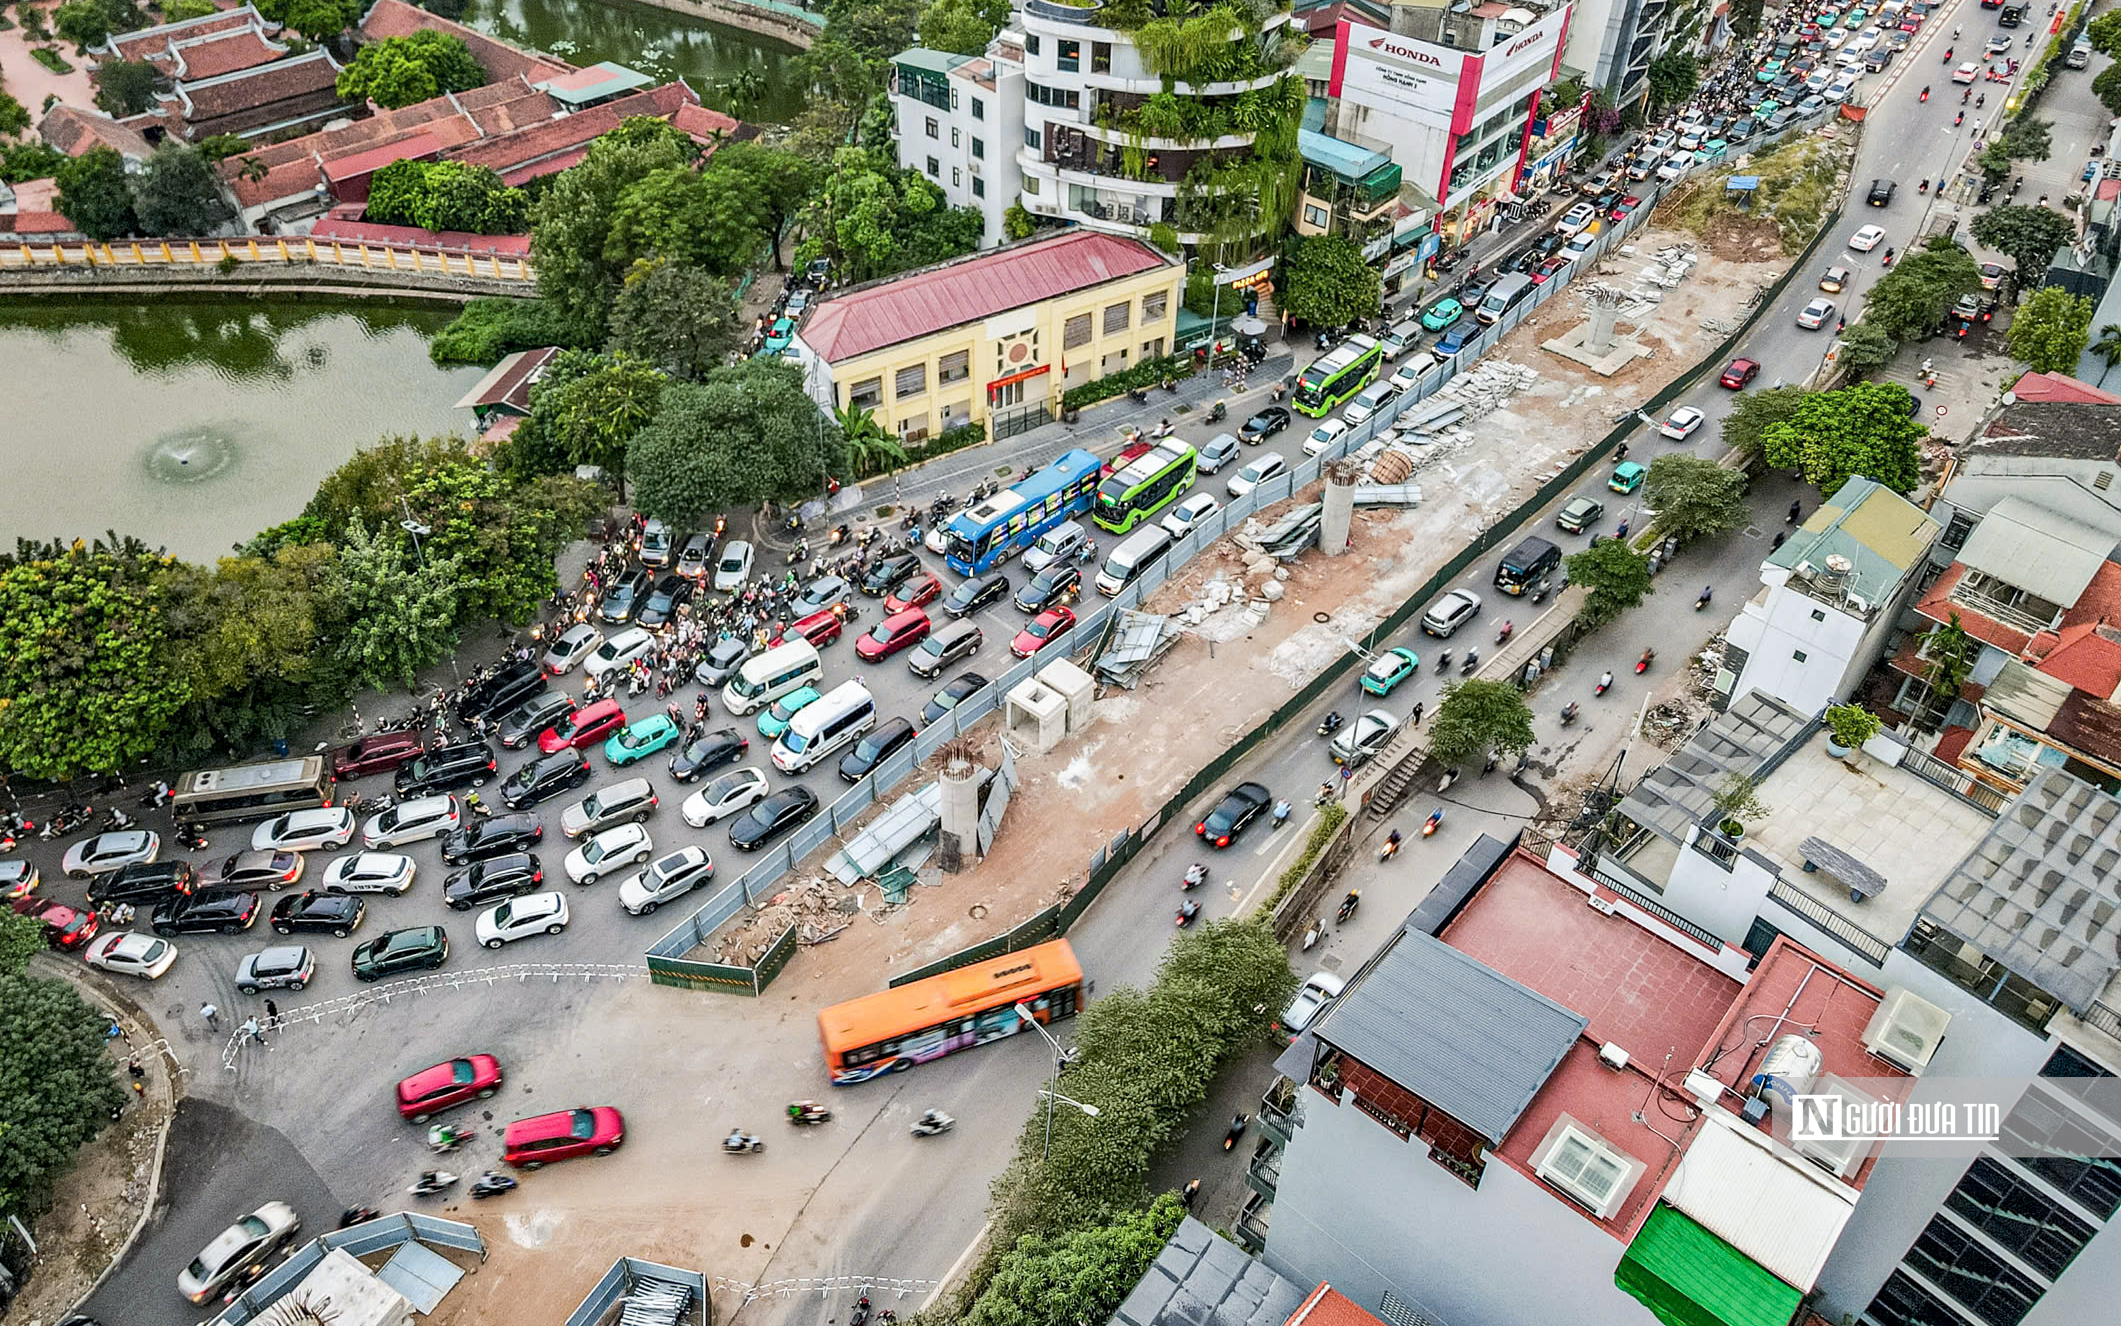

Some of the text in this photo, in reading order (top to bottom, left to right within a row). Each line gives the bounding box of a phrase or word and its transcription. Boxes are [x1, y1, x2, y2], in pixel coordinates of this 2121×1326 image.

[1514, 30, 1544, 53] HONDA
[1385, 43, 1441, 67] HONDA
[1232, 275, 1255, 290] PIZZA
